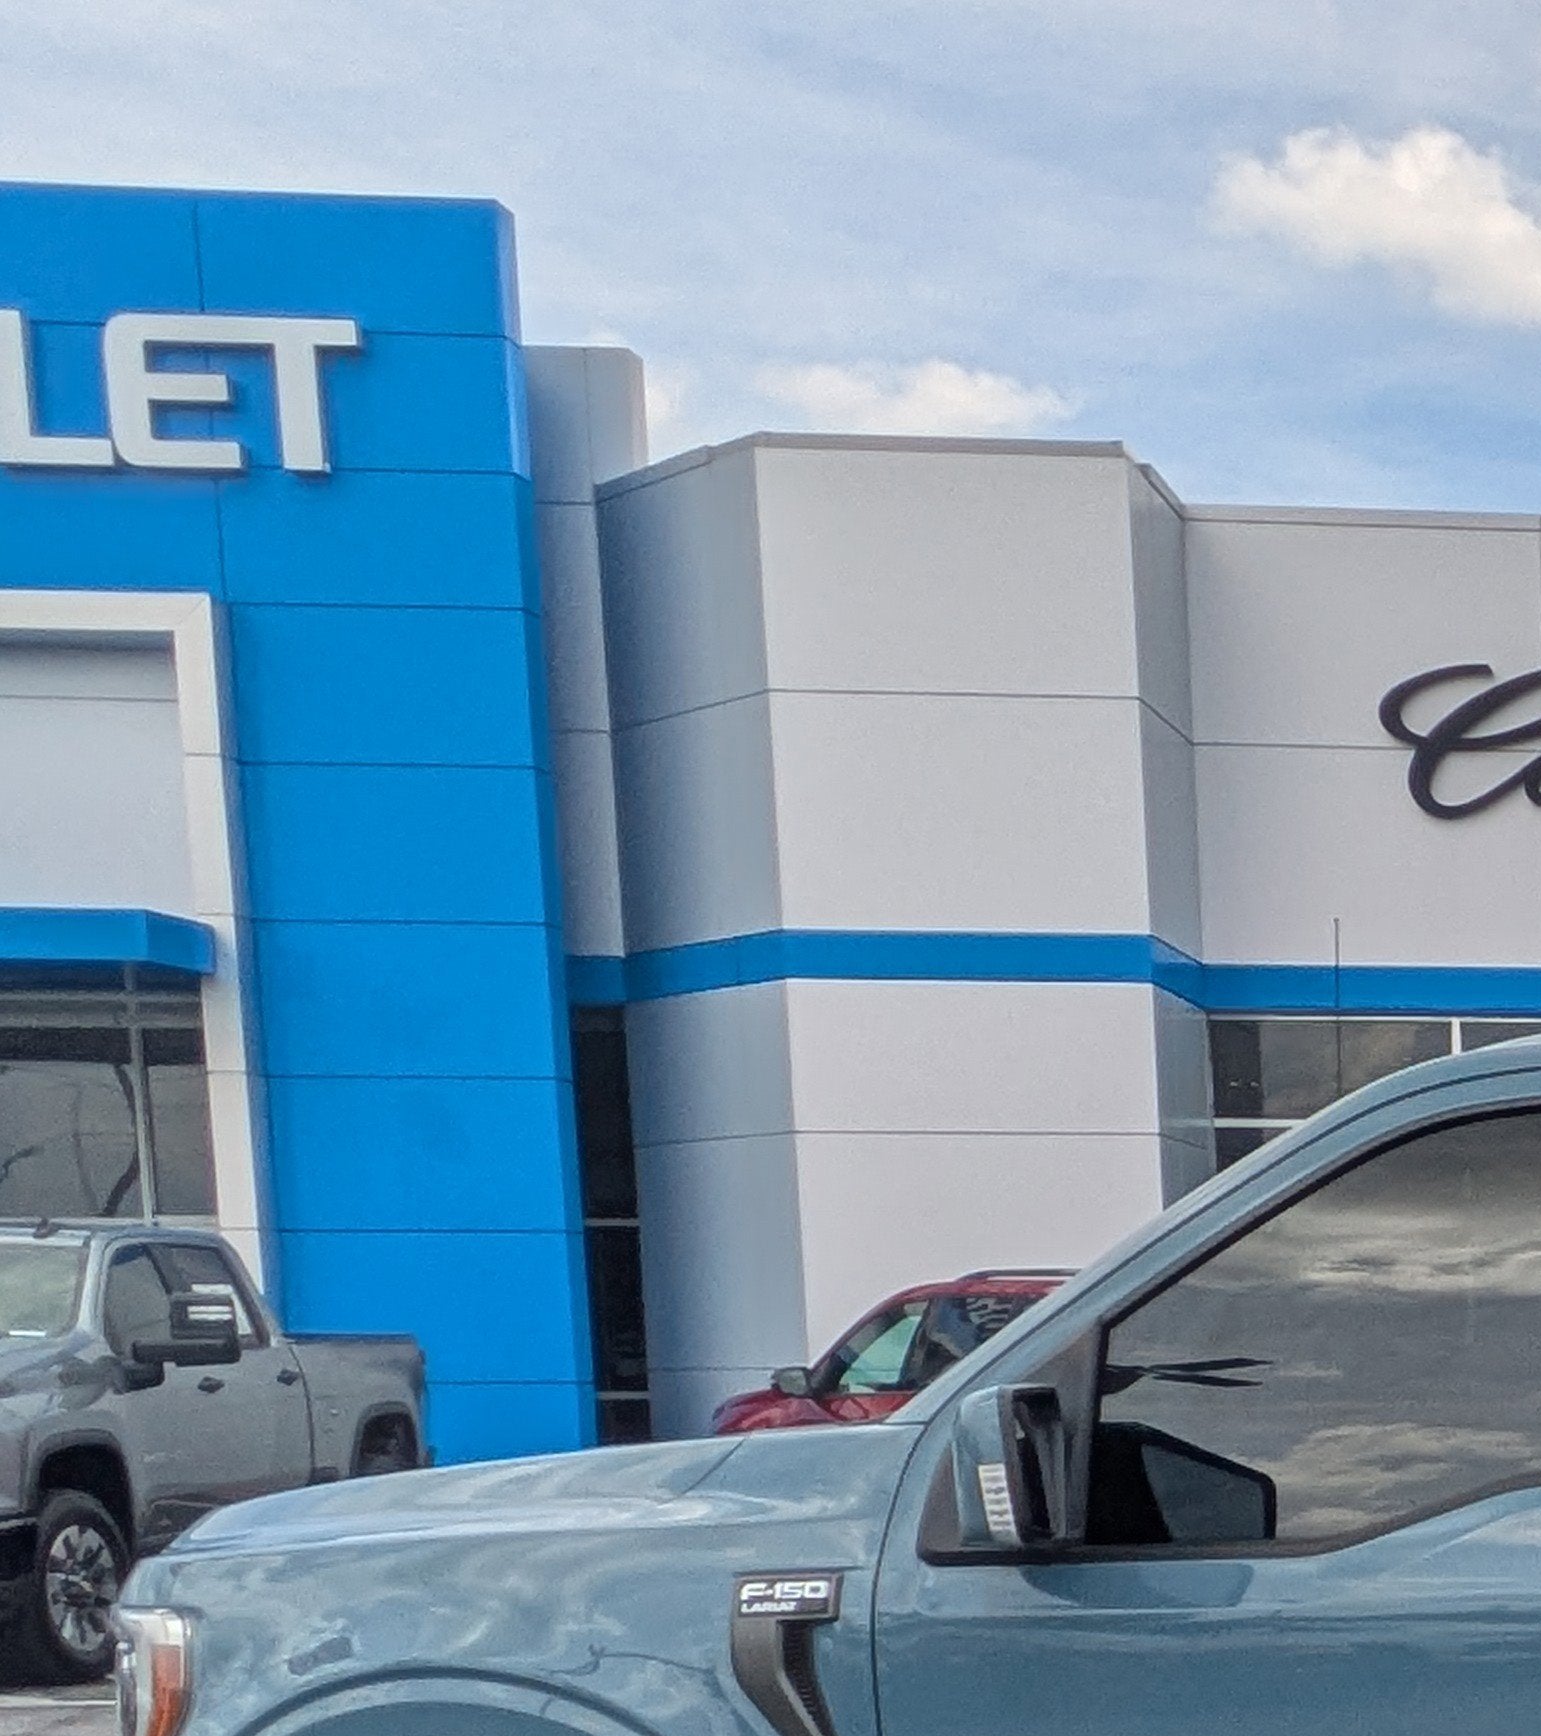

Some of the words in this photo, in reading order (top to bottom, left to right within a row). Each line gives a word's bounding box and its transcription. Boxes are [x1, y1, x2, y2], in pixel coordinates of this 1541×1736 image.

[0, 309, 358, 472] LET
[740, 1580, 830, 1600] F-150
[740, 1601, 797, 1613] LARIAT
